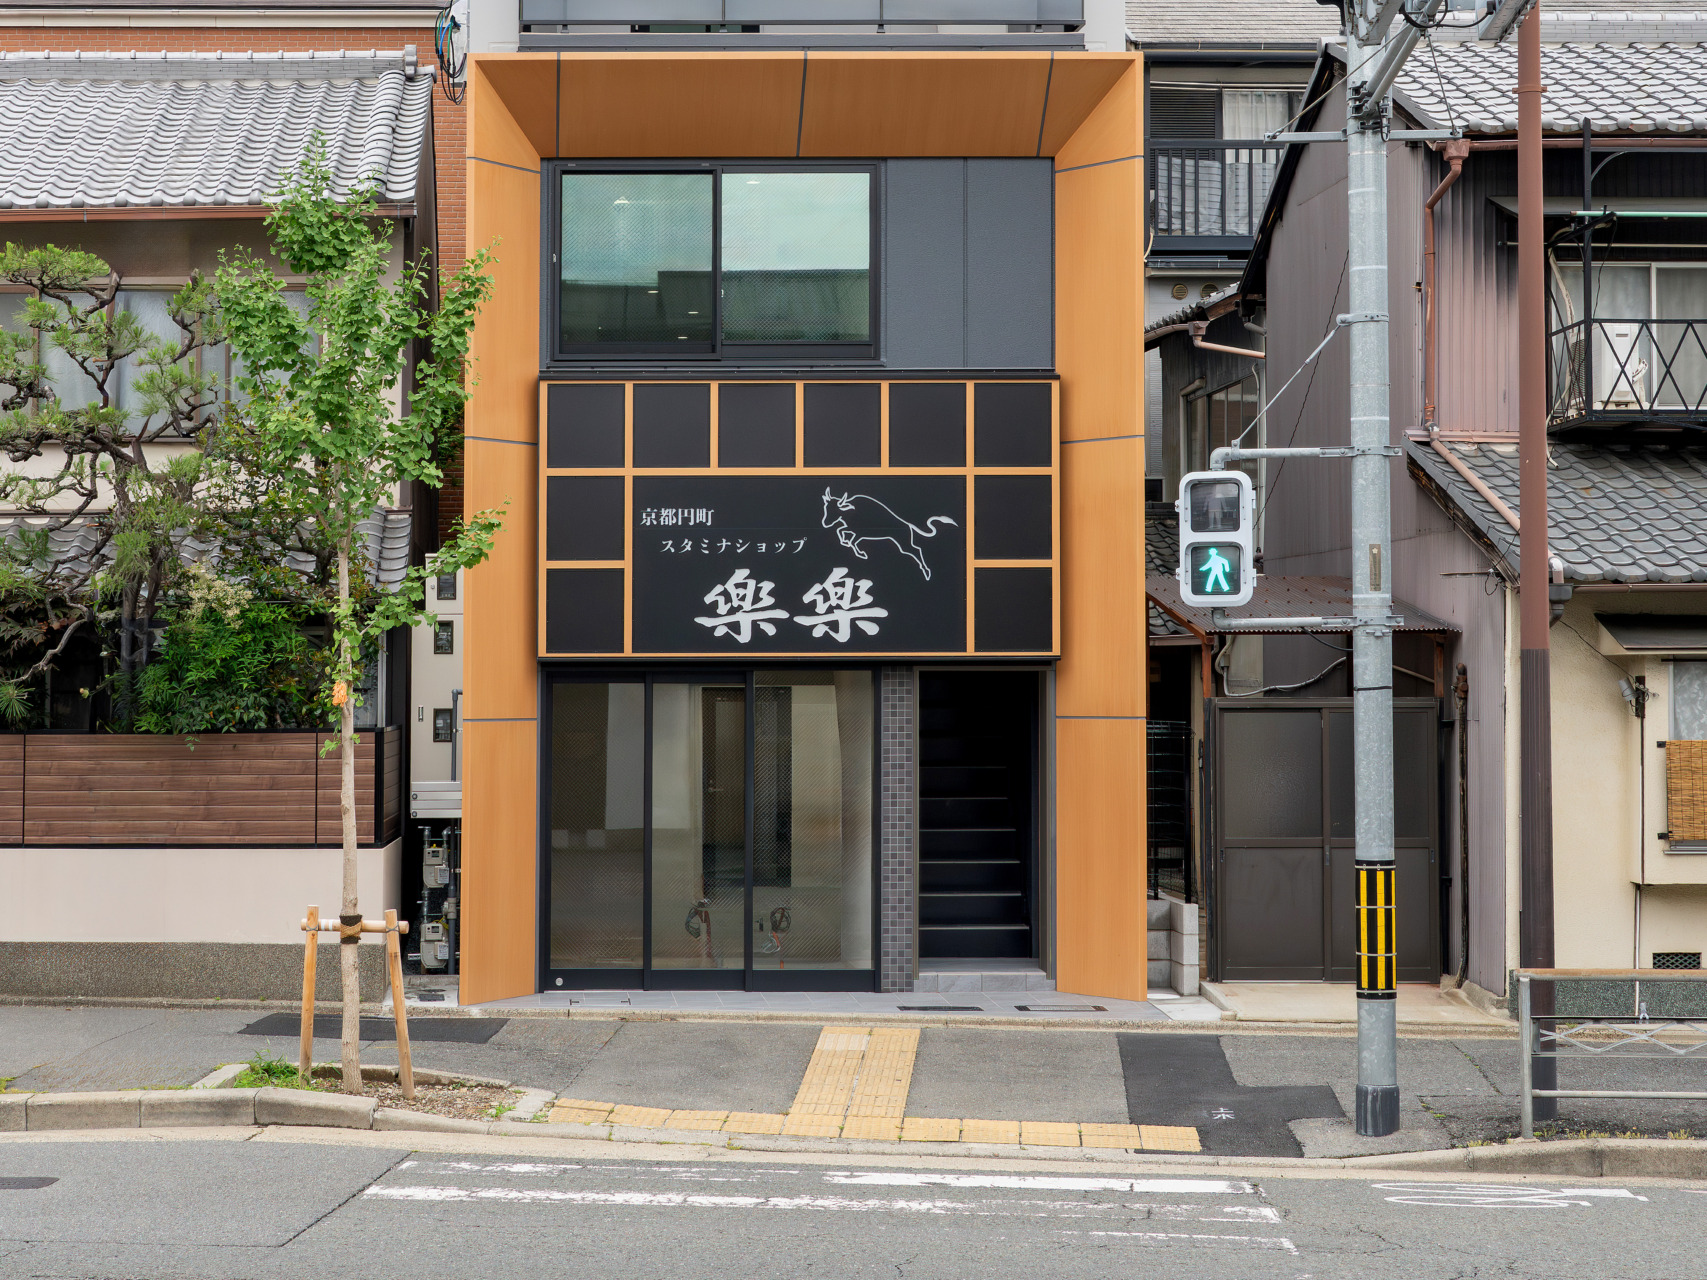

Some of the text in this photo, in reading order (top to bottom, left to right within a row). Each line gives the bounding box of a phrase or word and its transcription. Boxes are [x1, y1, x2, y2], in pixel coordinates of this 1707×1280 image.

[640, 507, 715, 526] 京都円町
[660, 536, 808, 554] スタミナショップ
